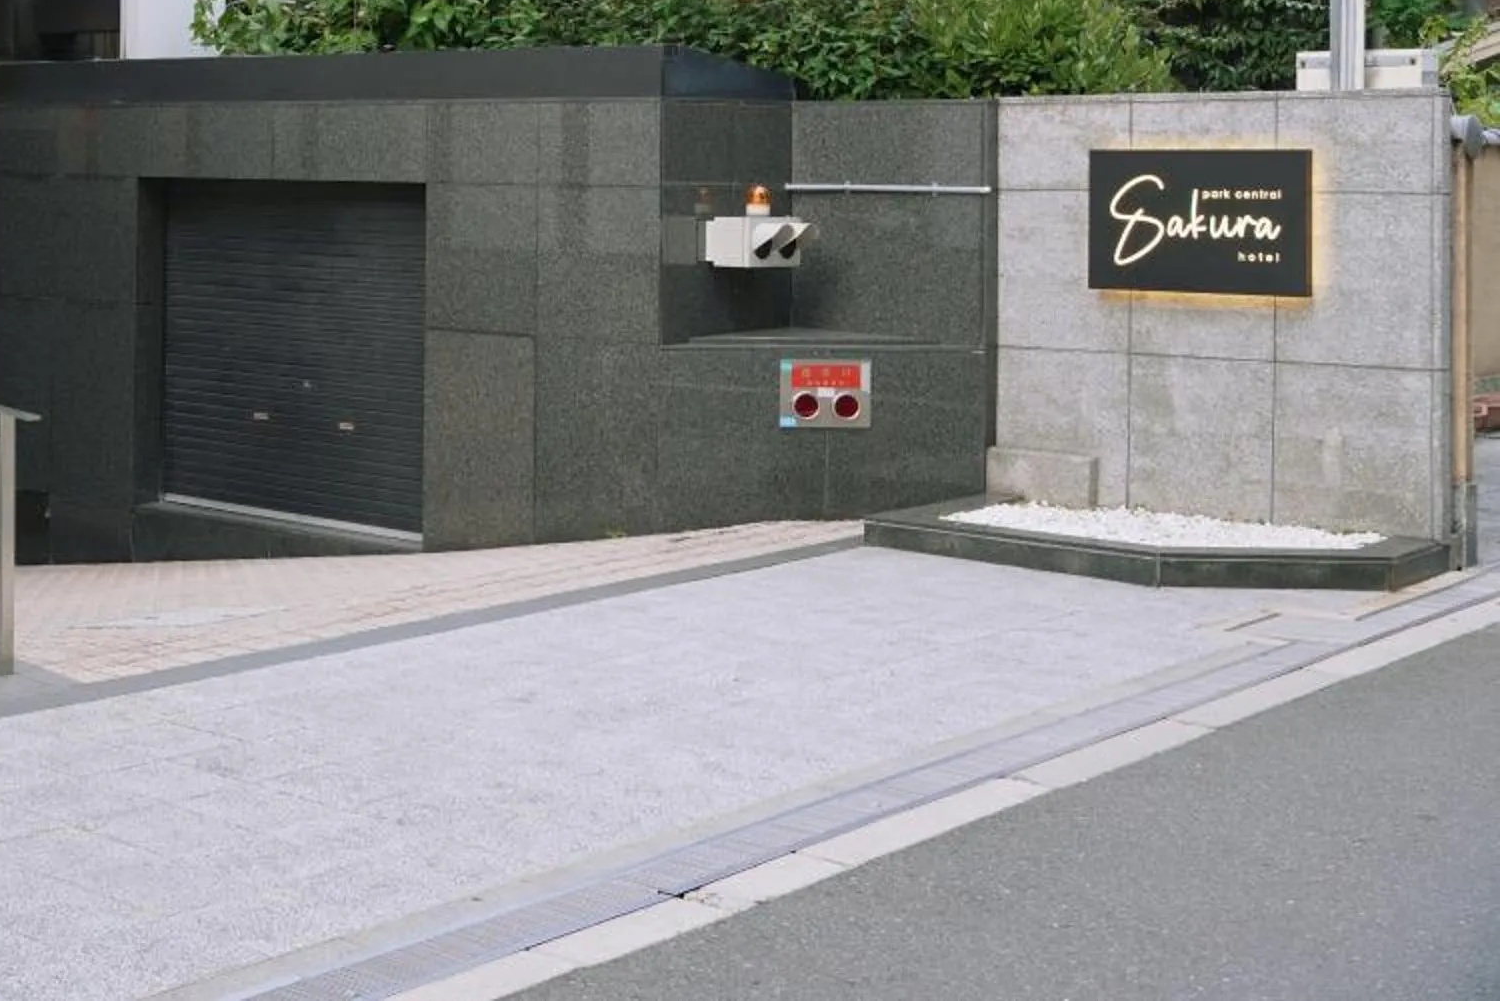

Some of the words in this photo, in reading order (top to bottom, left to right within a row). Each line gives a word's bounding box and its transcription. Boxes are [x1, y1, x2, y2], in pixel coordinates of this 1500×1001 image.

[1201, 188, 1231, 200] park
[1234, 188, 1282, 200] central
[1109, 174, 1282, 266] Sakura
[1237, 251, 1280, 263] hotel
